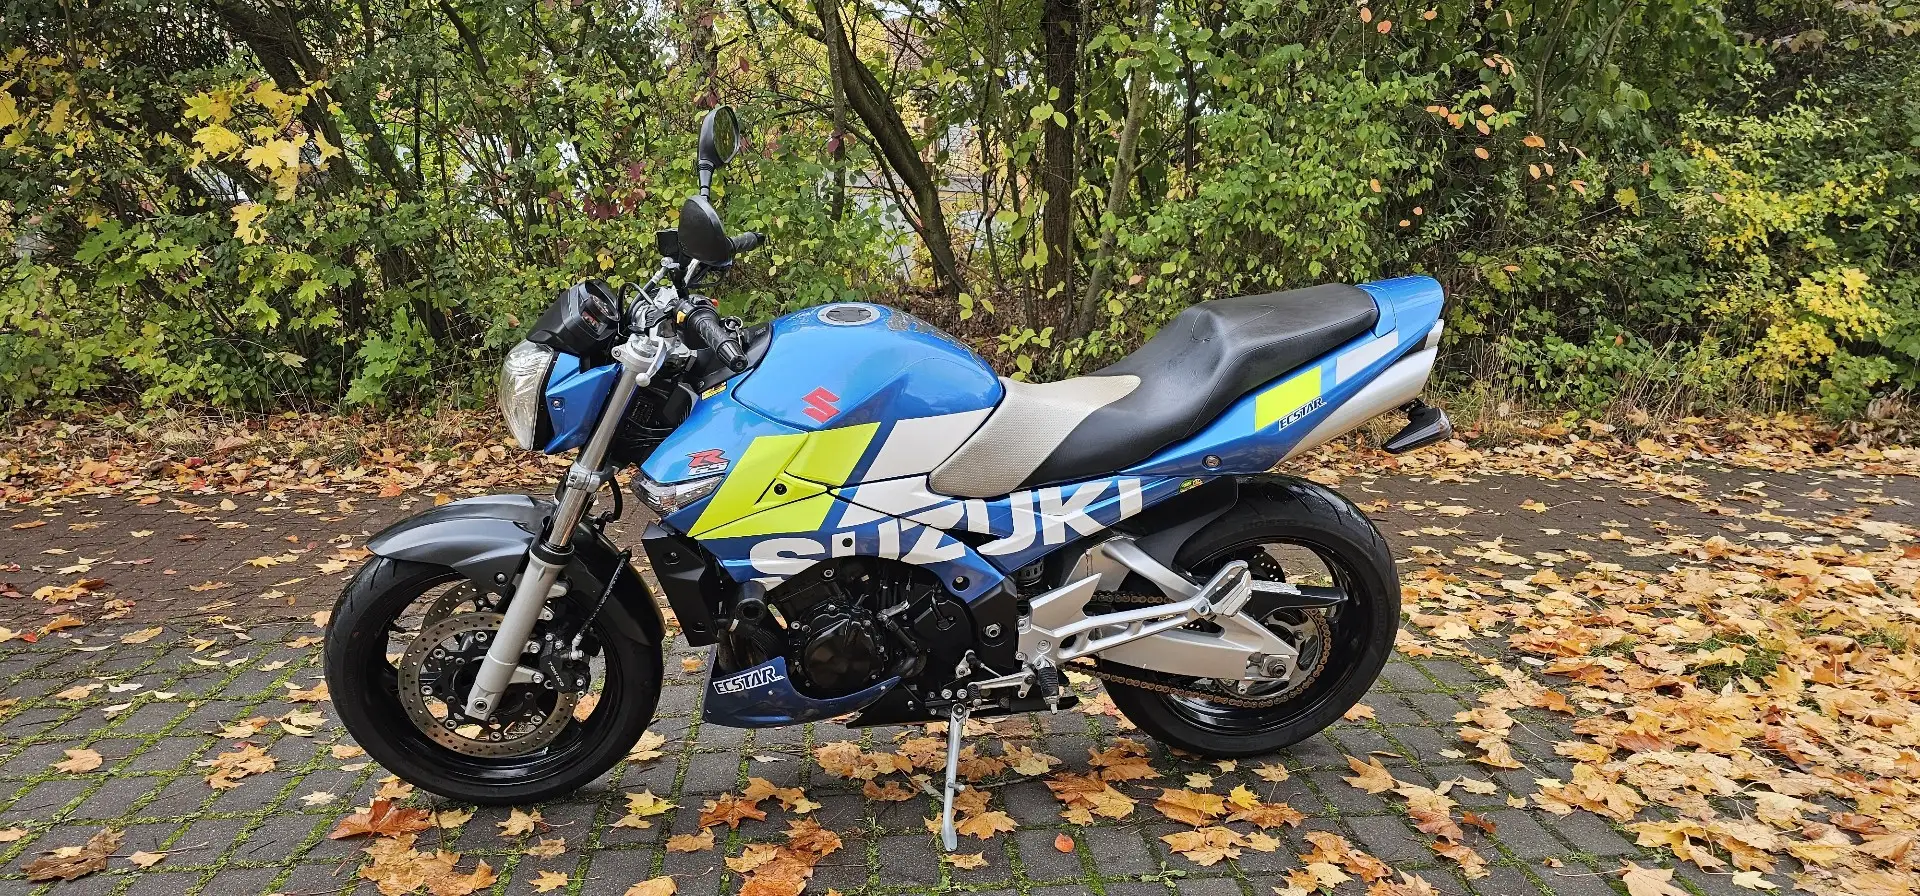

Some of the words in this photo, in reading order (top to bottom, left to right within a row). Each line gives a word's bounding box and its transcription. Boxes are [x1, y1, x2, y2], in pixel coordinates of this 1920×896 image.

[1278, 396, 1327, 431] ECSTAR
[750, 478, 1143, 591] SUZUKI
[713, 665, 785, 694] ECSTAR
